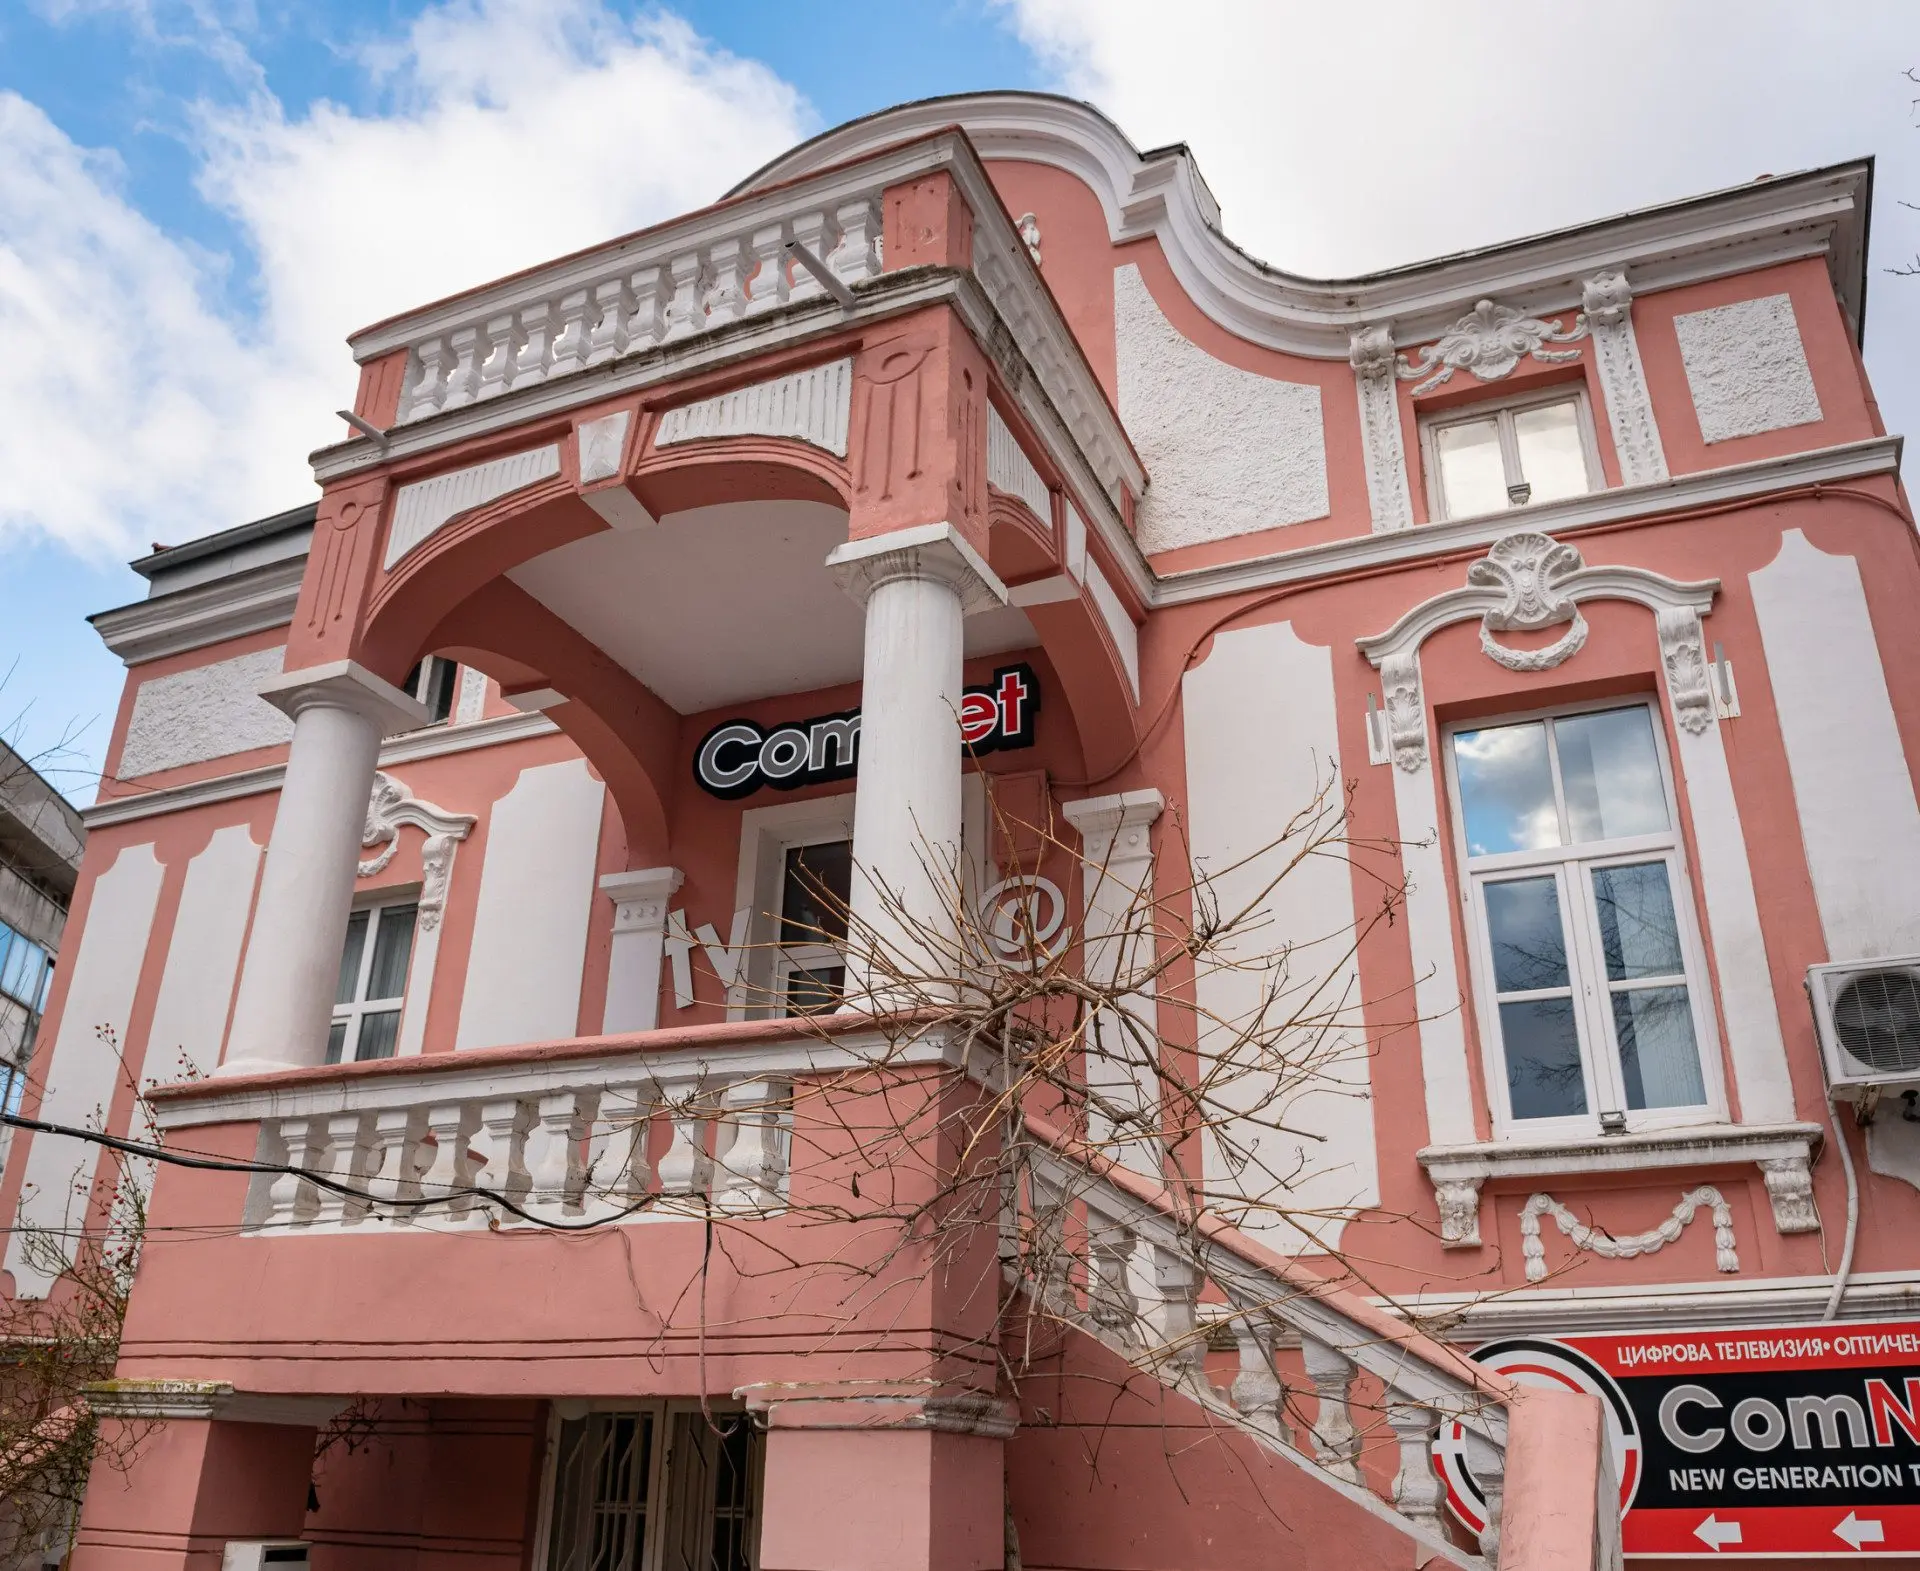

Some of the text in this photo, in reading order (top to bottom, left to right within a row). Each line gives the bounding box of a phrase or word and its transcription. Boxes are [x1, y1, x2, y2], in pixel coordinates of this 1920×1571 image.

[699, 671, 1027, 788] Comet
[1617, 1343, 1712, 1368] ЦИФРОВА
[1669, 1468, 1725, 1491] NEW
[1733, 1463, 1904, 1490] GENERATION
